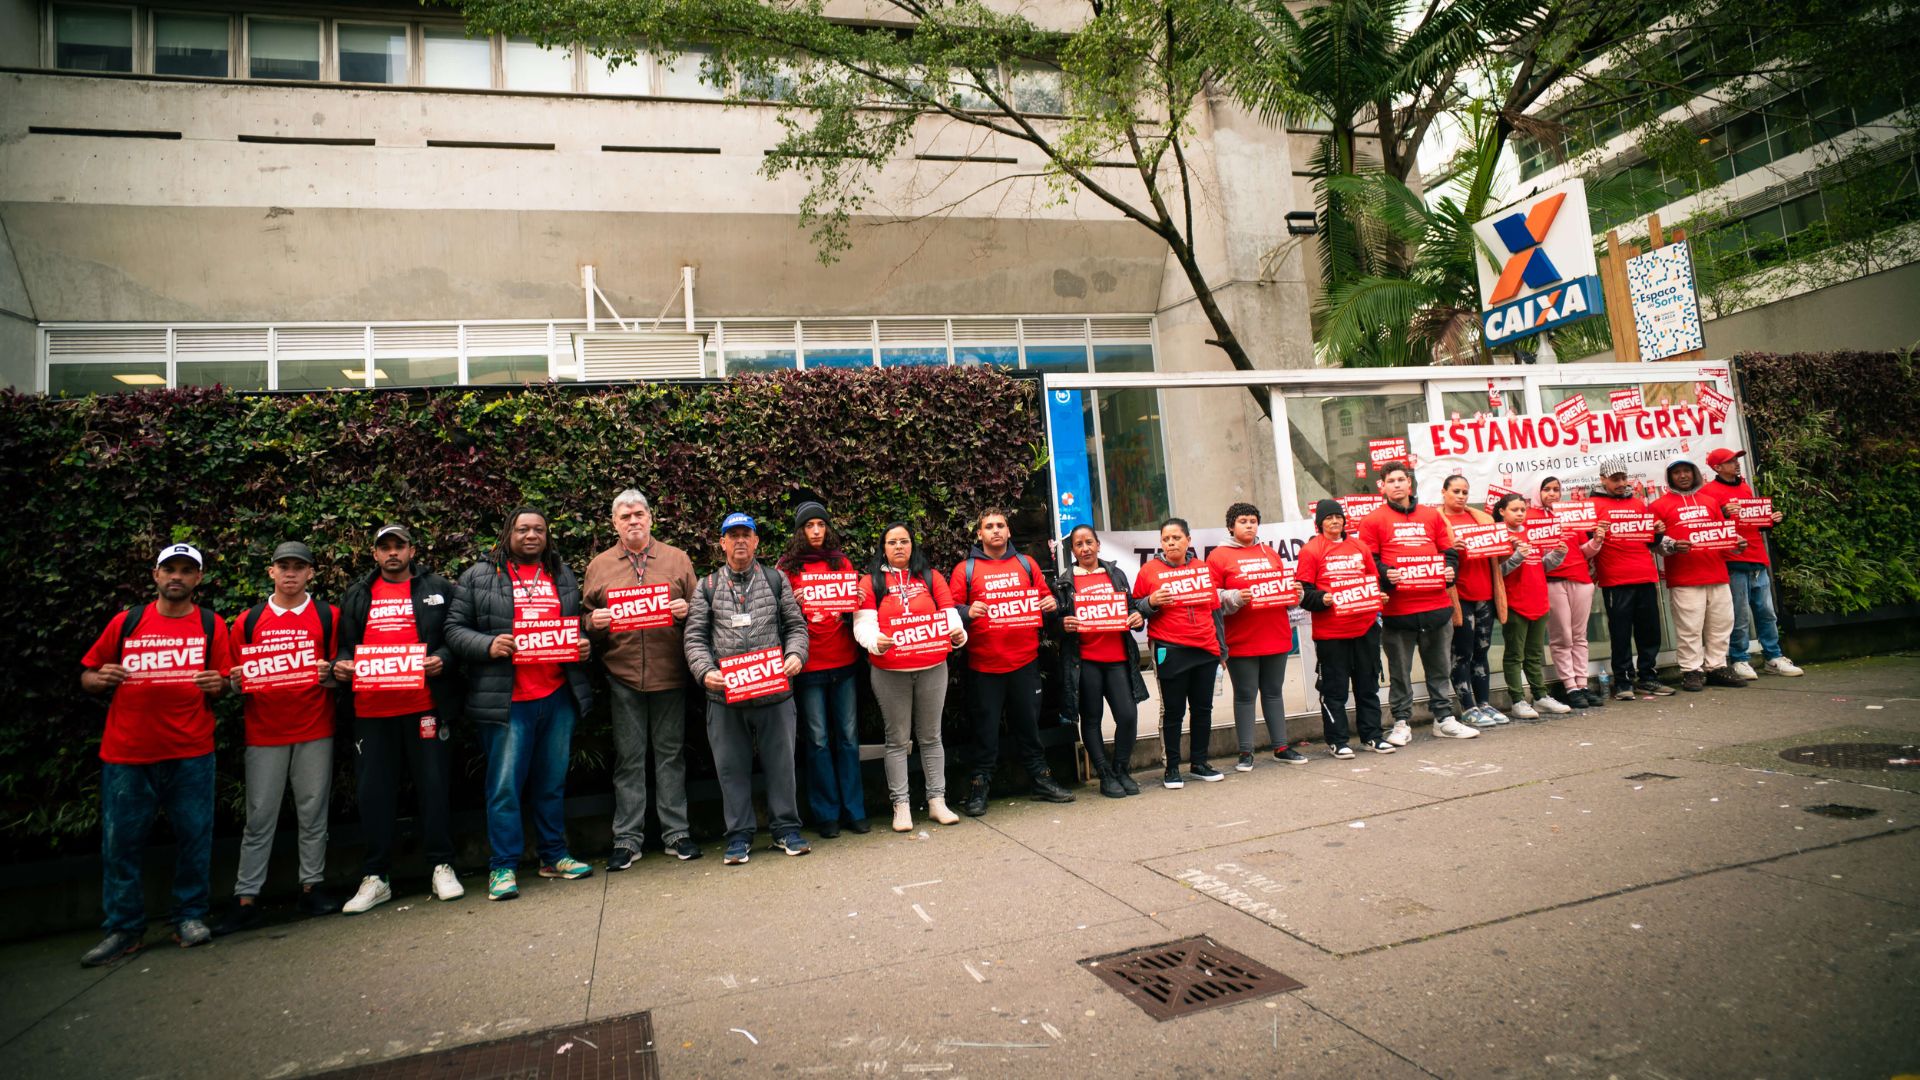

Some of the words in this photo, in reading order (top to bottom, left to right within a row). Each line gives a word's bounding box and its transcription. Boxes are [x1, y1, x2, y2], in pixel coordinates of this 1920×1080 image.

[1654, 294, 1684, 309] Sorte
[1485, 283, 1587, 341] CAIXA
[1611, 396, 1641, 411] GREVE
[1560, 401, 1588, 424] GREVE
[1429, 415, 1580, 457] ESTAMOS
[1587, 411, 1629, 443] EM
[1637, 404, 1724, 441] GREVE
[1371, 445, 1407, 461] GREVE
[1498, 456, 1562, 475] COMISSÃO
[1565, 456, 1580, 469] DE
[1348, 501, 1383, 517] GREVE
[1555, 507, 1597, 523] GREVE
[1679, 509, 1709, 521] GREVE
[1739, 504, 1772, 519] GREVE
[1526, 524, 1561, 541] GREVE
[1610, 519, 1654, 534] GREVE
[1688, 521, 1723, 529] ESTAMOS
[1464, 530, 1510, 550] GREVE
[1689, 526, 1737, 544] GREVE
[802, 572, 842, 581] ESTAMOS
[844, 572, 857, 580] EM
[1158, 568, 1194, 580] ESTAMOS
[1196, 566, 1210, 575] EM
[1248, 572, 1282, 581] ESTAMOS
[1398, 562, 1444, 580] GREVE
[803, 580, 858, 601] GREVE
[984, 576, 1020, 590] GREVE
[1160, 574, 1212, 596] GREVE
[1250, 576, 1295, 598] GREVE
[1330, 578, 1364, 588] ESTAMOS
[608, 586, 653, 599] ESTAMOS
[654, 584, 669, 594] EM
[986, 590, 1026, 600] ESTAMOS
[1332, 583, 1380, 606] GREVE
[369, 604, 414, 618] GREVE
[609, 594, 670, 620] GREVE
[987, 598, 1040, 620] GREVE
[1076, 602, 1128, 621] GREVE
[514, 620, 562, 629] ESTAMOS
[563, 618, 578, 627] EM
[890, 614, 931, 626] ESTAMOS
[261, 629, 296, 637] ESTAMOS
[514, 628, 579, 651] GREVE
[892, 620, 950, 647] GREVE
[124, 638, 184, 648] ESTAMOS
[186, 637, 204, 646] EM
[242, 642, 296, 655] ESTAMOS
[298, 640, 314, 649] EM
[356, 646, 406, 655] ESTAMOS
[409, 645, 425, 654] EM
[122, 646, 204, 673] GREVE
[242, 648, 317, 679] GREVE
[354, 654, 424, 677] GREVE
[721, 653, 765, 669] ESTAMOS
[767, 649, 781, 658] EM
[724, 658, 785, 690] GREVE
